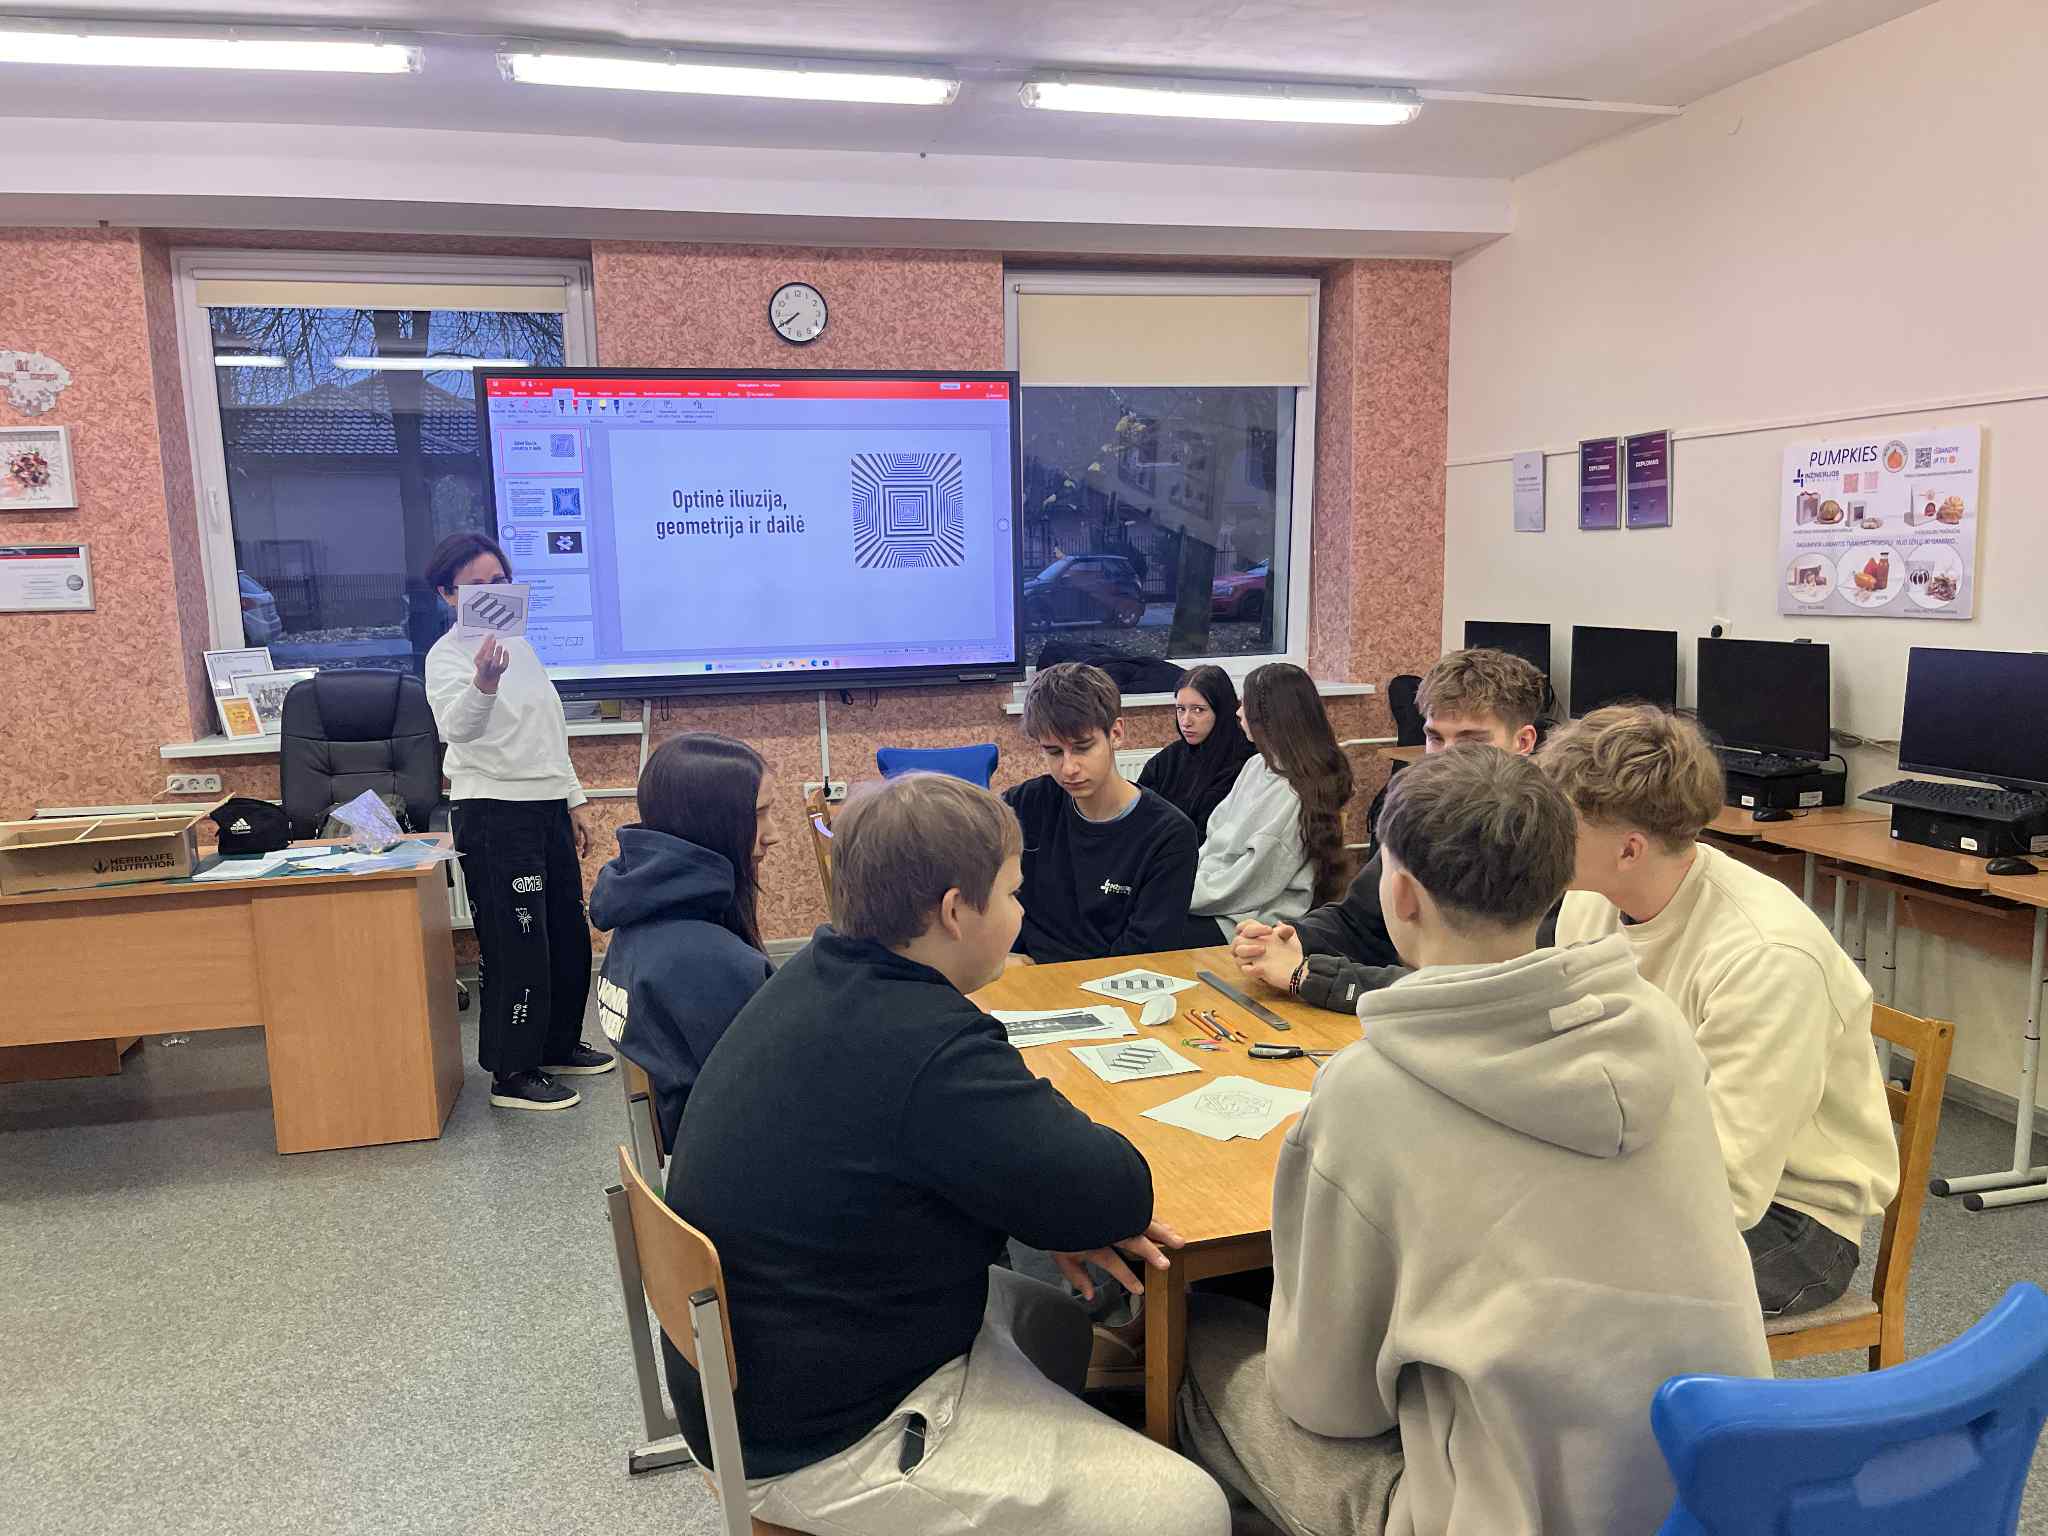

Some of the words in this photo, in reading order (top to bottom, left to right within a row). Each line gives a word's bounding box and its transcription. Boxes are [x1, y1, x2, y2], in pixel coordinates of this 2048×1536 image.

[1809, 445, 1878, 468] PUMPKIES
[672, 489, 725, 513] Optinė
[730, 489, 787, 512] iliuzija,
[656, 515, 744, 540] geometrija
[749, 515, 761, 534] ir
[766, 515, 805, 534] dailė
[110, 853, 176, 865] HERBALIFE
[111, 860, 176, 872] NUTRITION
